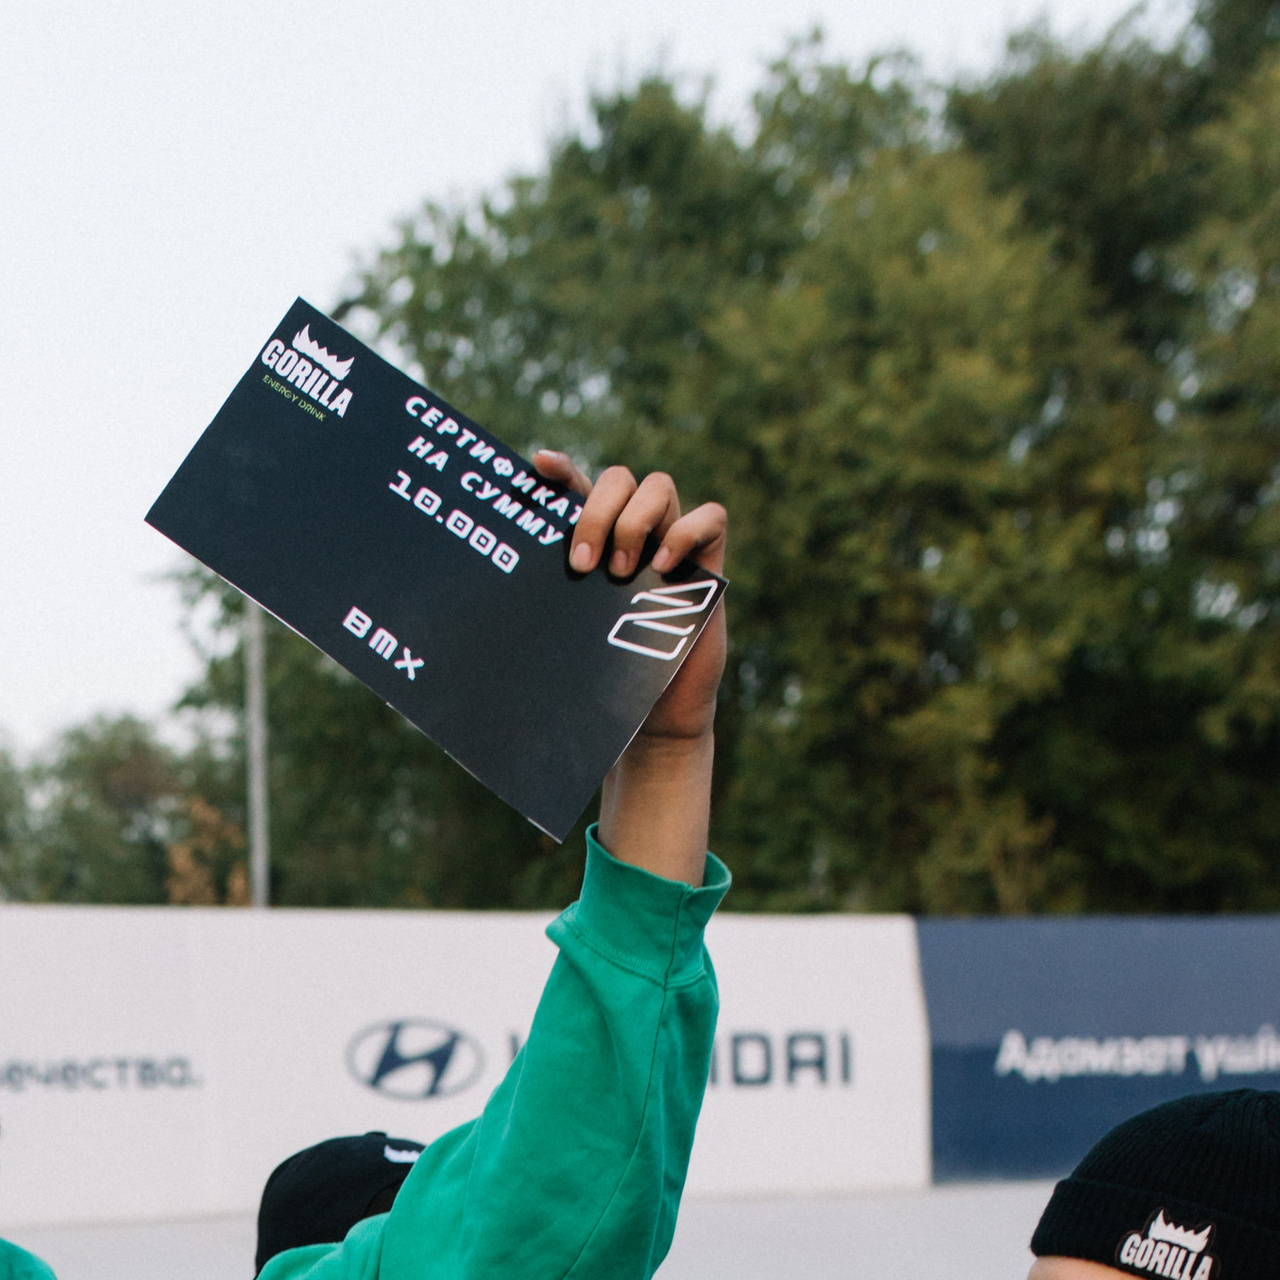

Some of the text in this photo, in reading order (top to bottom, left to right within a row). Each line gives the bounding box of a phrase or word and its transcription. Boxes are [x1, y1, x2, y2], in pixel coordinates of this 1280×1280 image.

[261, 338, 354, 419] GORILLA
[262, 374, 327, 422] ENERGY DRINK
[388, 469, 520, 574] 10.000
[407, 435, 564, 545] НА СУММУ
[342, 605, 425, 681] BMX
